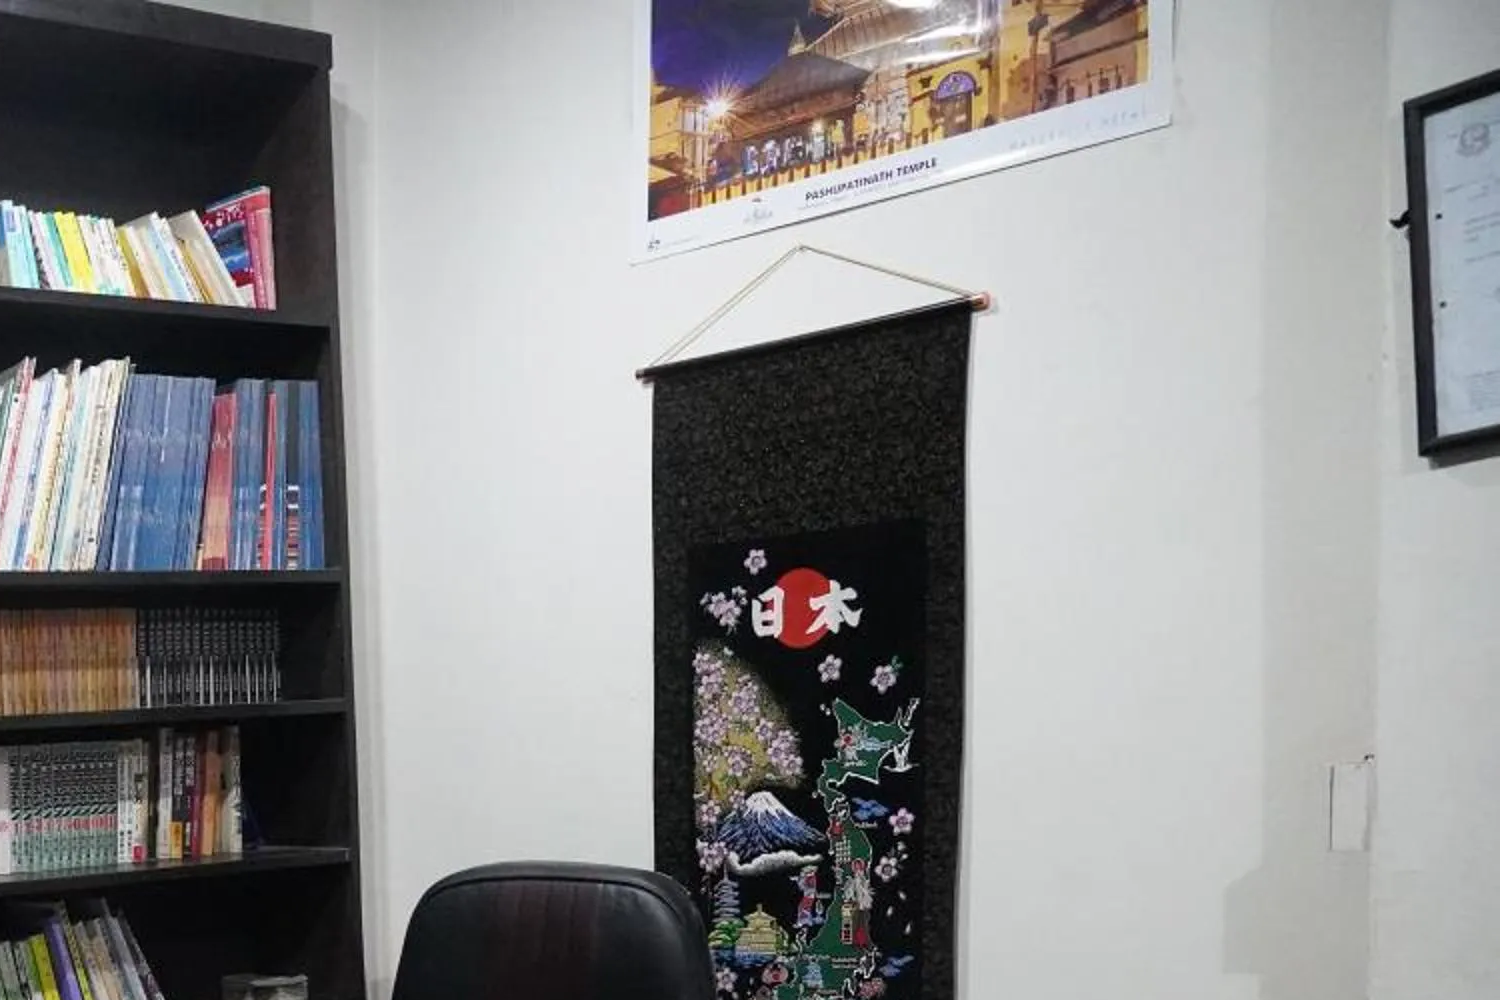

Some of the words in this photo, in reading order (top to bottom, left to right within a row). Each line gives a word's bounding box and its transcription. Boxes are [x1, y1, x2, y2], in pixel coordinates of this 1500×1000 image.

[804, 170, 894, 201] PASHUPATINATH
[896, 158, 938, 185] TEMPLE
[751, 579, 864, 639] 日本
